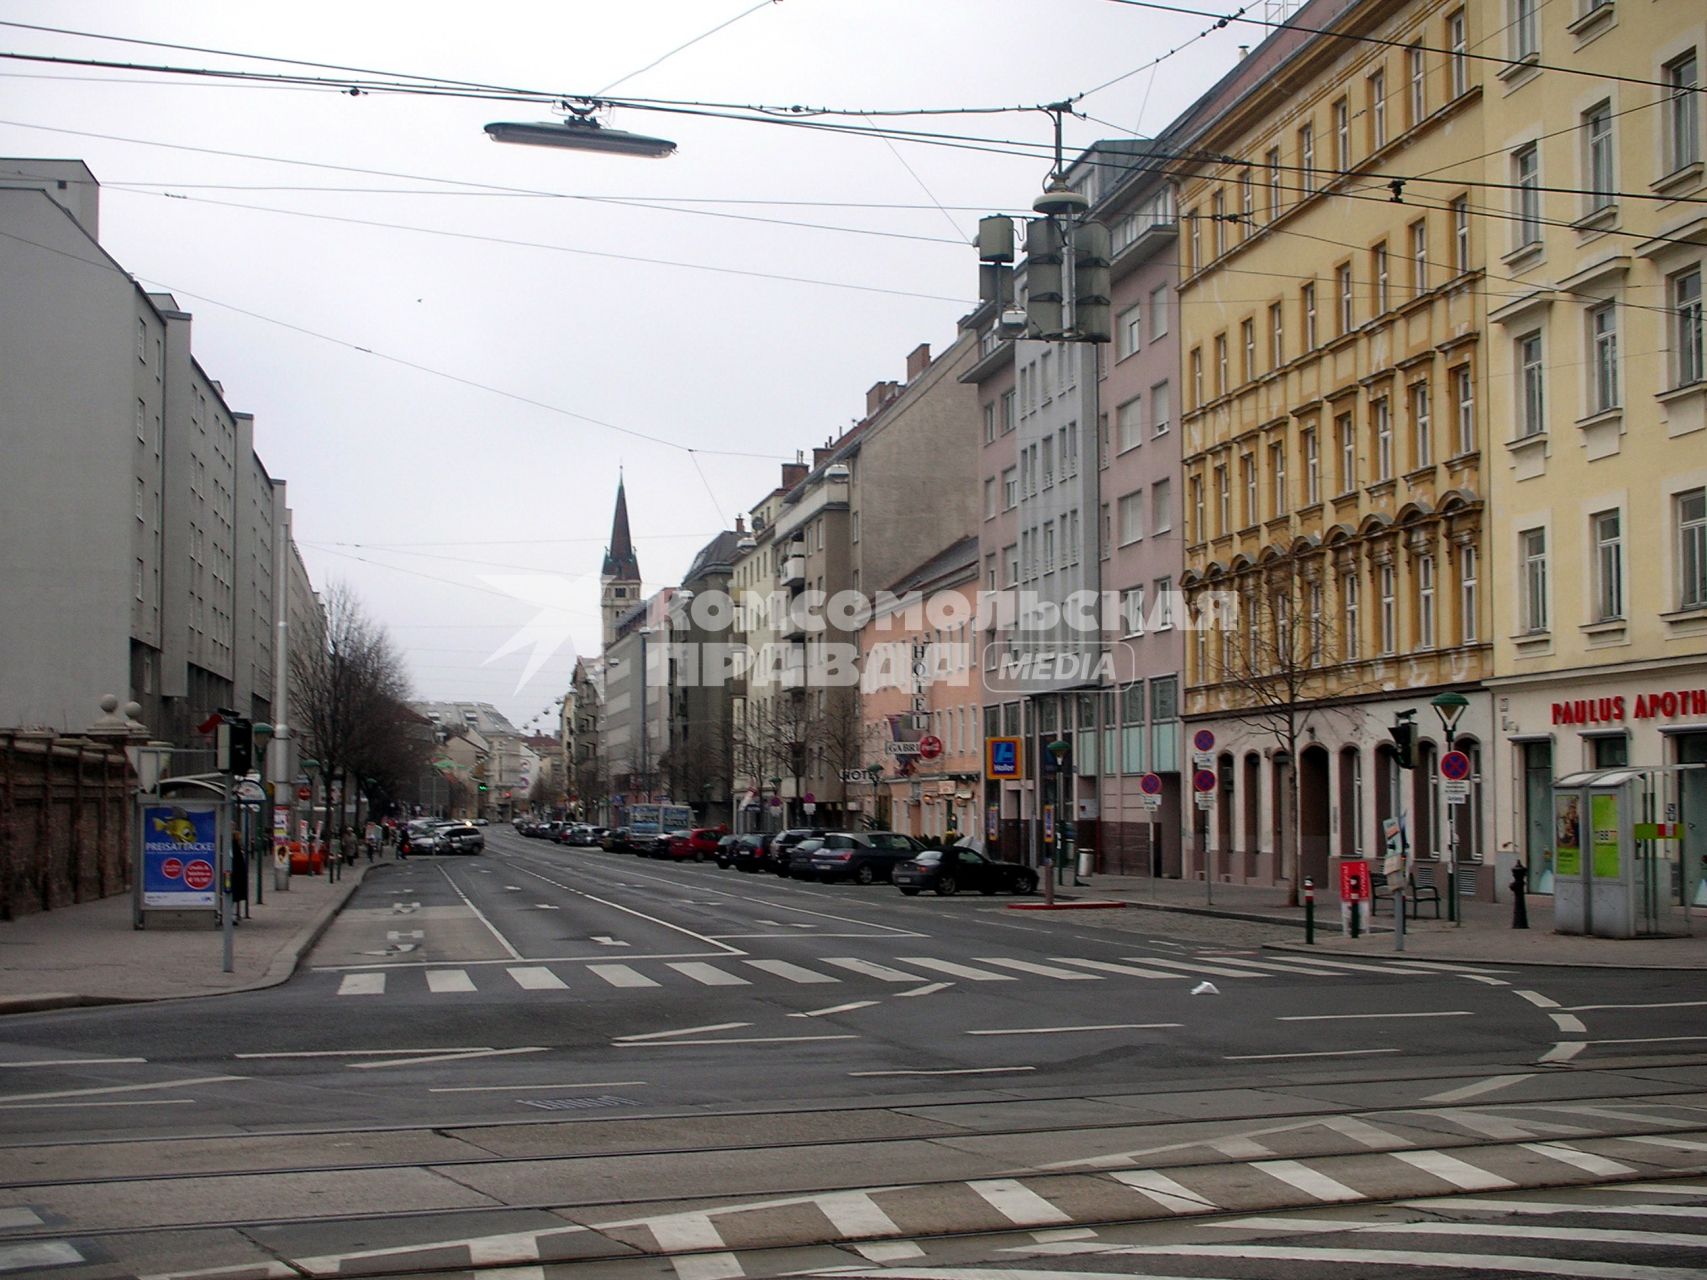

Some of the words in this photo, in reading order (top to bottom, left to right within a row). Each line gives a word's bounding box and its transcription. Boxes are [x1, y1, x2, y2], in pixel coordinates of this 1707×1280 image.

[914, 645, 927, 729] HOTEL
[1552, 696, 1624, 724] PAULUS
[1634, 690, 1707, 718] APOTH
